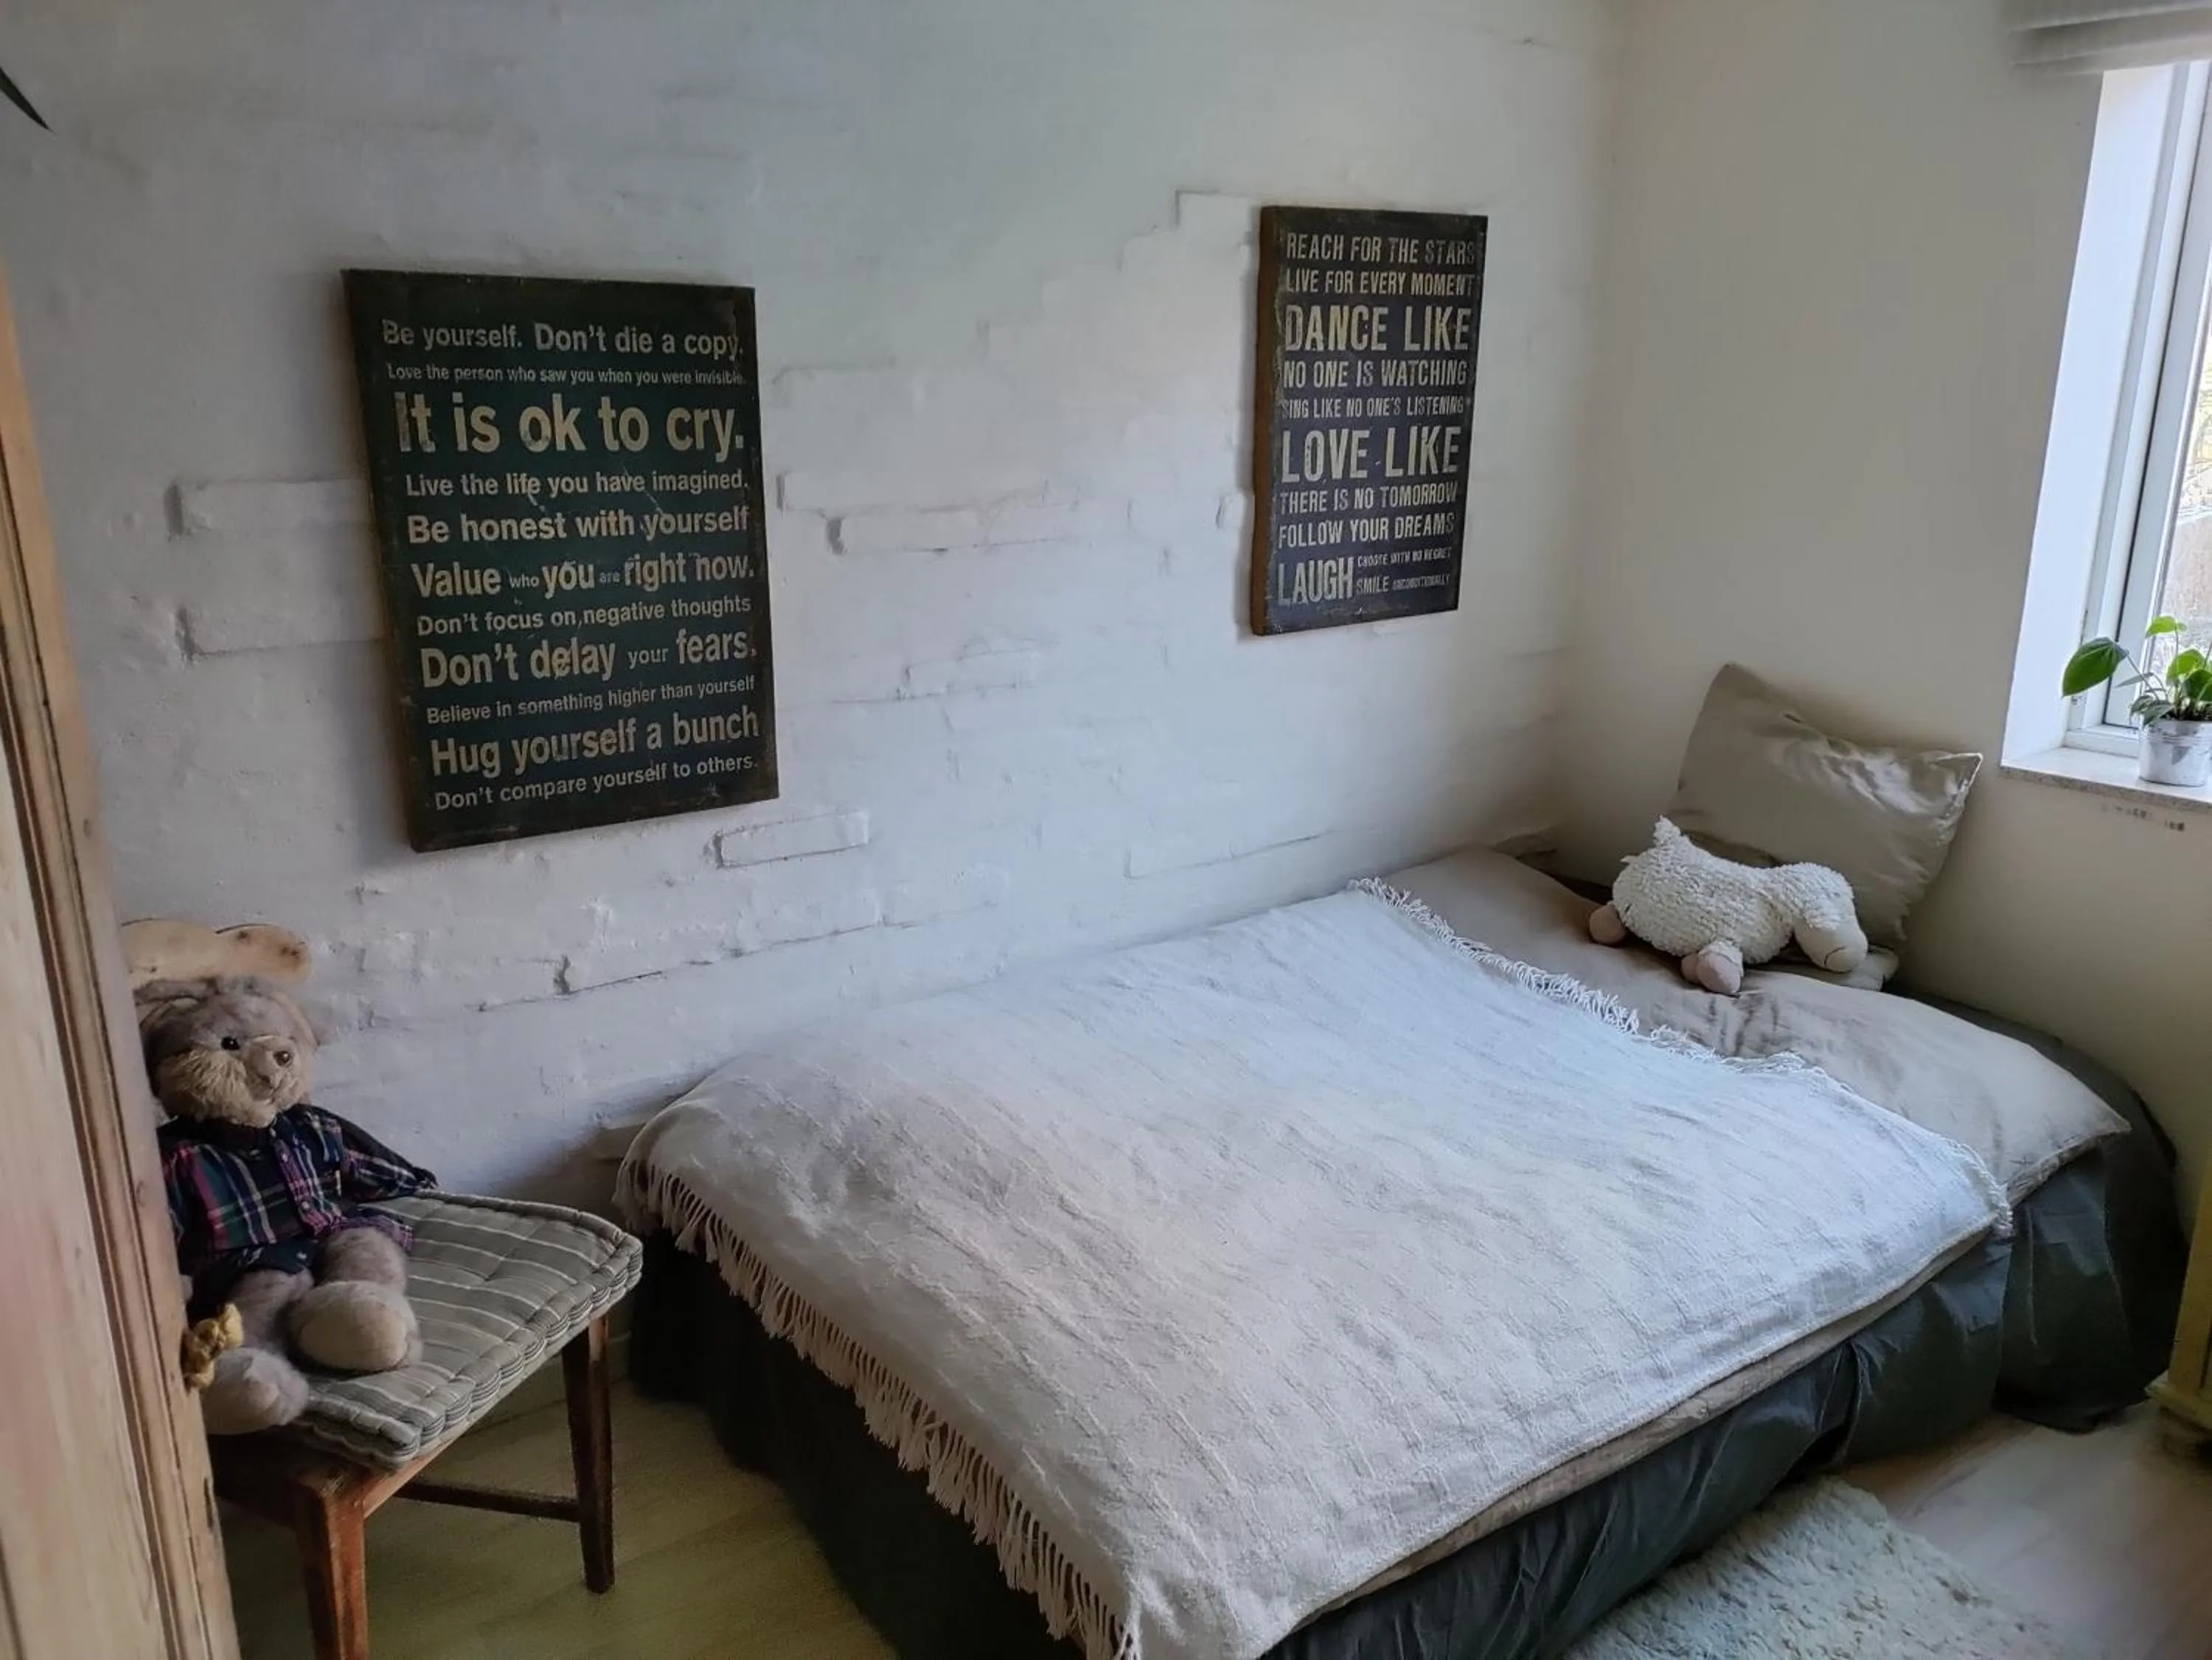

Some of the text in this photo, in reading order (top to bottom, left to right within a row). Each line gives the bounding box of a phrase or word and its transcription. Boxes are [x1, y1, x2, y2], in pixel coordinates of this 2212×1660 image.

[1287, 232, 1475, 265] REACH FOR THE STARS
[1287, 268, 1475, 296] LIVE FOR EVERY MOMENT
[382, 319, 743, 361] Be yourself. Don't die a copy.
[1285, 304, 1472, 352] DANCE LIKE
[388, 364, 422, 379] Love
[426, 365, 449, 380] the
[454, 367, 504, 383] person
[507, 366, 535, 381] who
[540, 369, 567, 382] saw
[570, 370, 594, 386] you
[598, 369, 632, 383] when
[636, 370, 658, 386] you
[662, 371, 691, 384] were
[1284, 359, 1467, 388] NO ONE IS WATCHING
[394, 391, 744, 463] It is ok to cry.
[1313, 397, 1341, 418] LIKE
[1346, 397, 1363, 418] NO
[1366, 396, 1401, 417] ONE'S
[1407, 395, 1464, 416] LISTENING
[1281, 425, 1461, 483] LOVE LIKE
[406, 469, 748, 500] Live the life you have imagined.
[1280, 481, 1458, 515] THERE IS NO TOMORROW
[407, 506, 750, 544] Be honest with yourself
[1278, 512, 1455, 549] FOLLOW YOUR DREAMS
[411, 553, 754, 599] Value who you are right now.
[1278, 557, 1354, 606] LAUGH
[1356, 576, 1389, 594] SMILE
[417, 613, 478, 637] Don't
[484, 612, 544, 632] focus
[584, 601, 664, 627] negative
[671, 596, 751, 618] thoughts
[420, 628, 757, 688] Don't delay your fears.
[427, 675, 756, 725] Believe in something higher than yourself
[431, 705, 759, 780] Hug yourself a bunch
[434, 753, 758, 811] Don't compare yourself to others.
